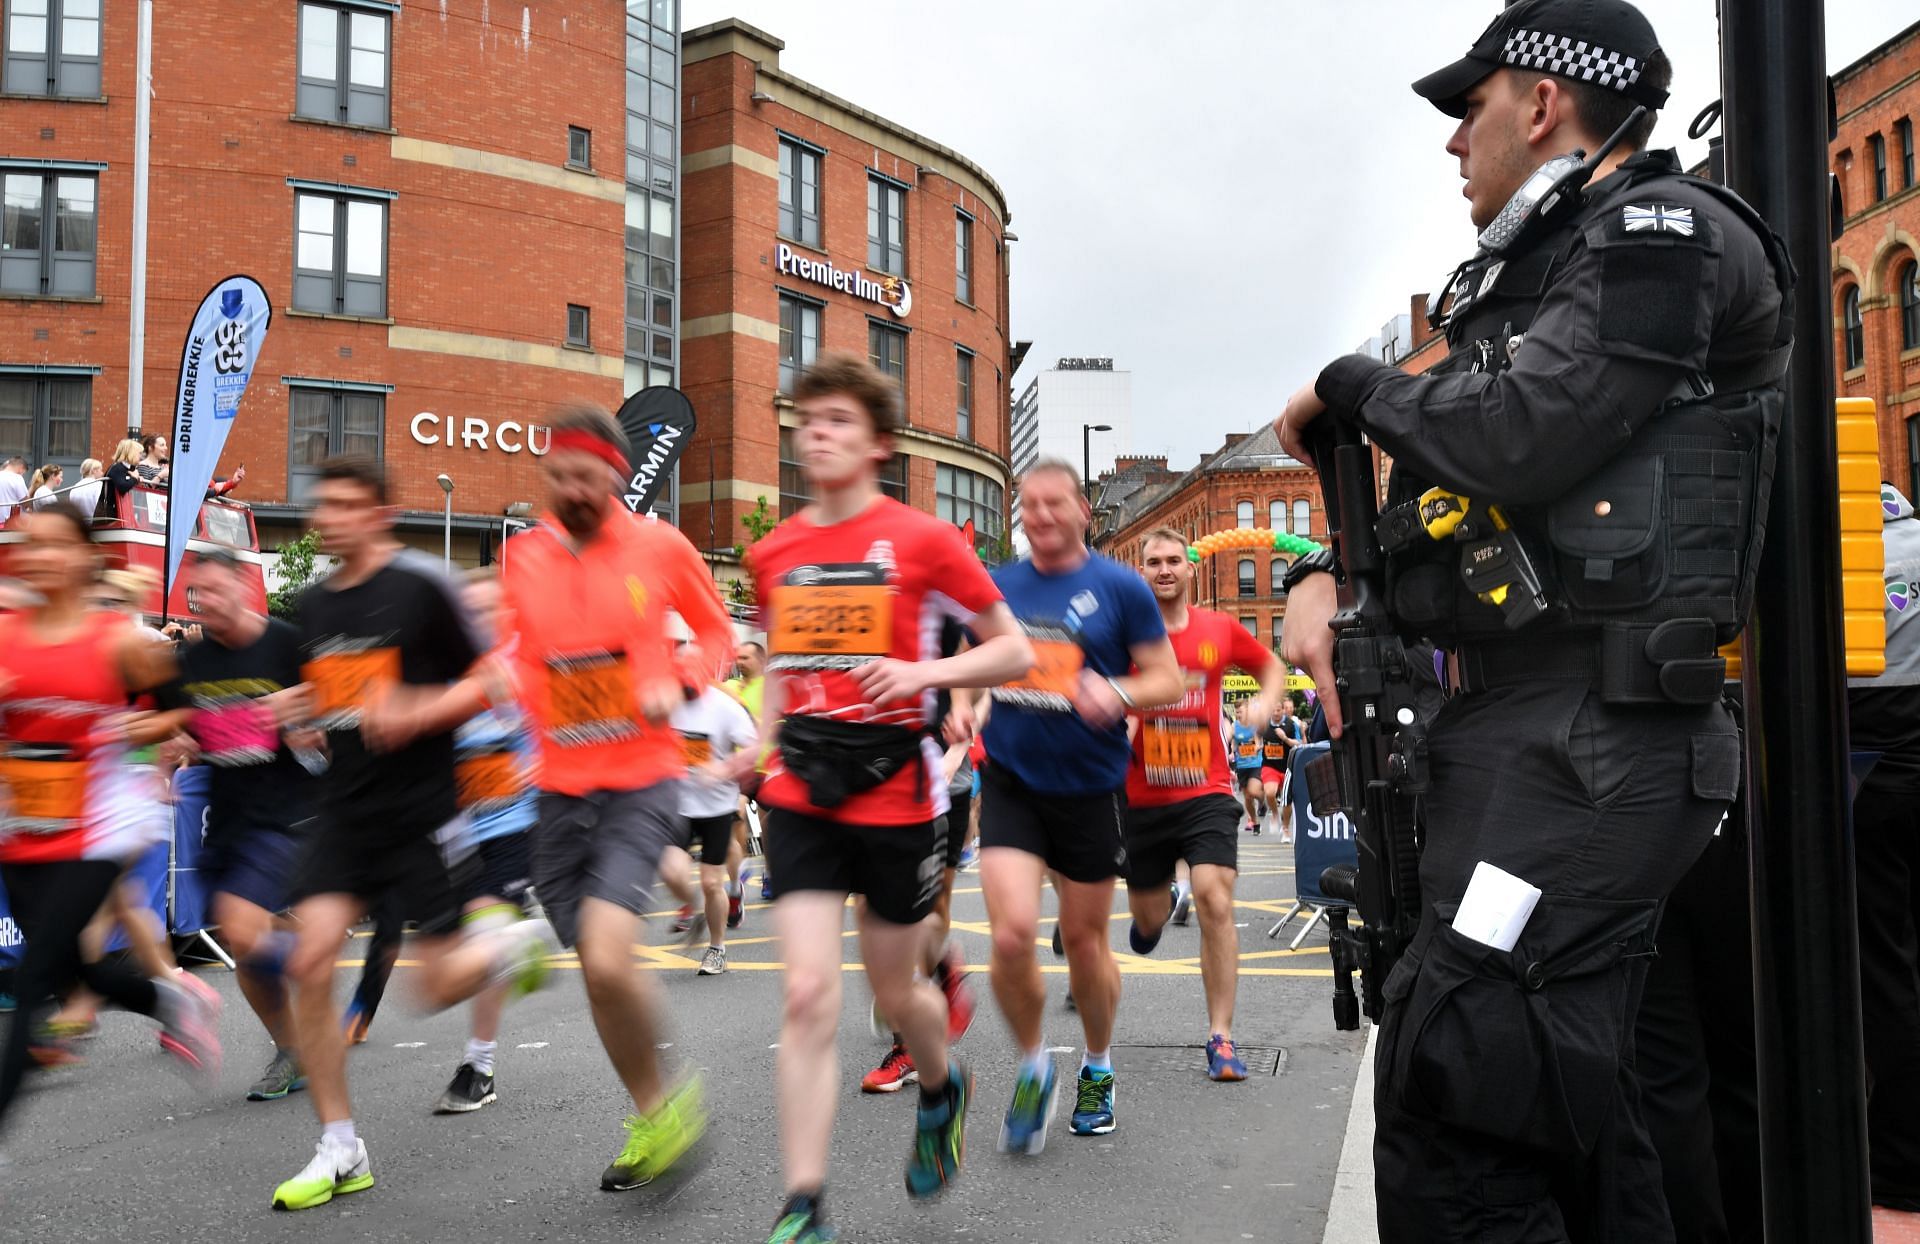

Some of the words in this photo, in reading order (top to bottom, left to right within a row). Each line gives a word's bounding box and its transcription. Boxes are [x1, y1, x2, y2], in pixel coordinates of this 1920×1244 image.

[775, 244, 853, 294] Premier
[853, 270, 882, 303] Inn
[180, 336, 205, 453] #DRINKBREKKIE
[410, 412, 552, 456] CIRCU
